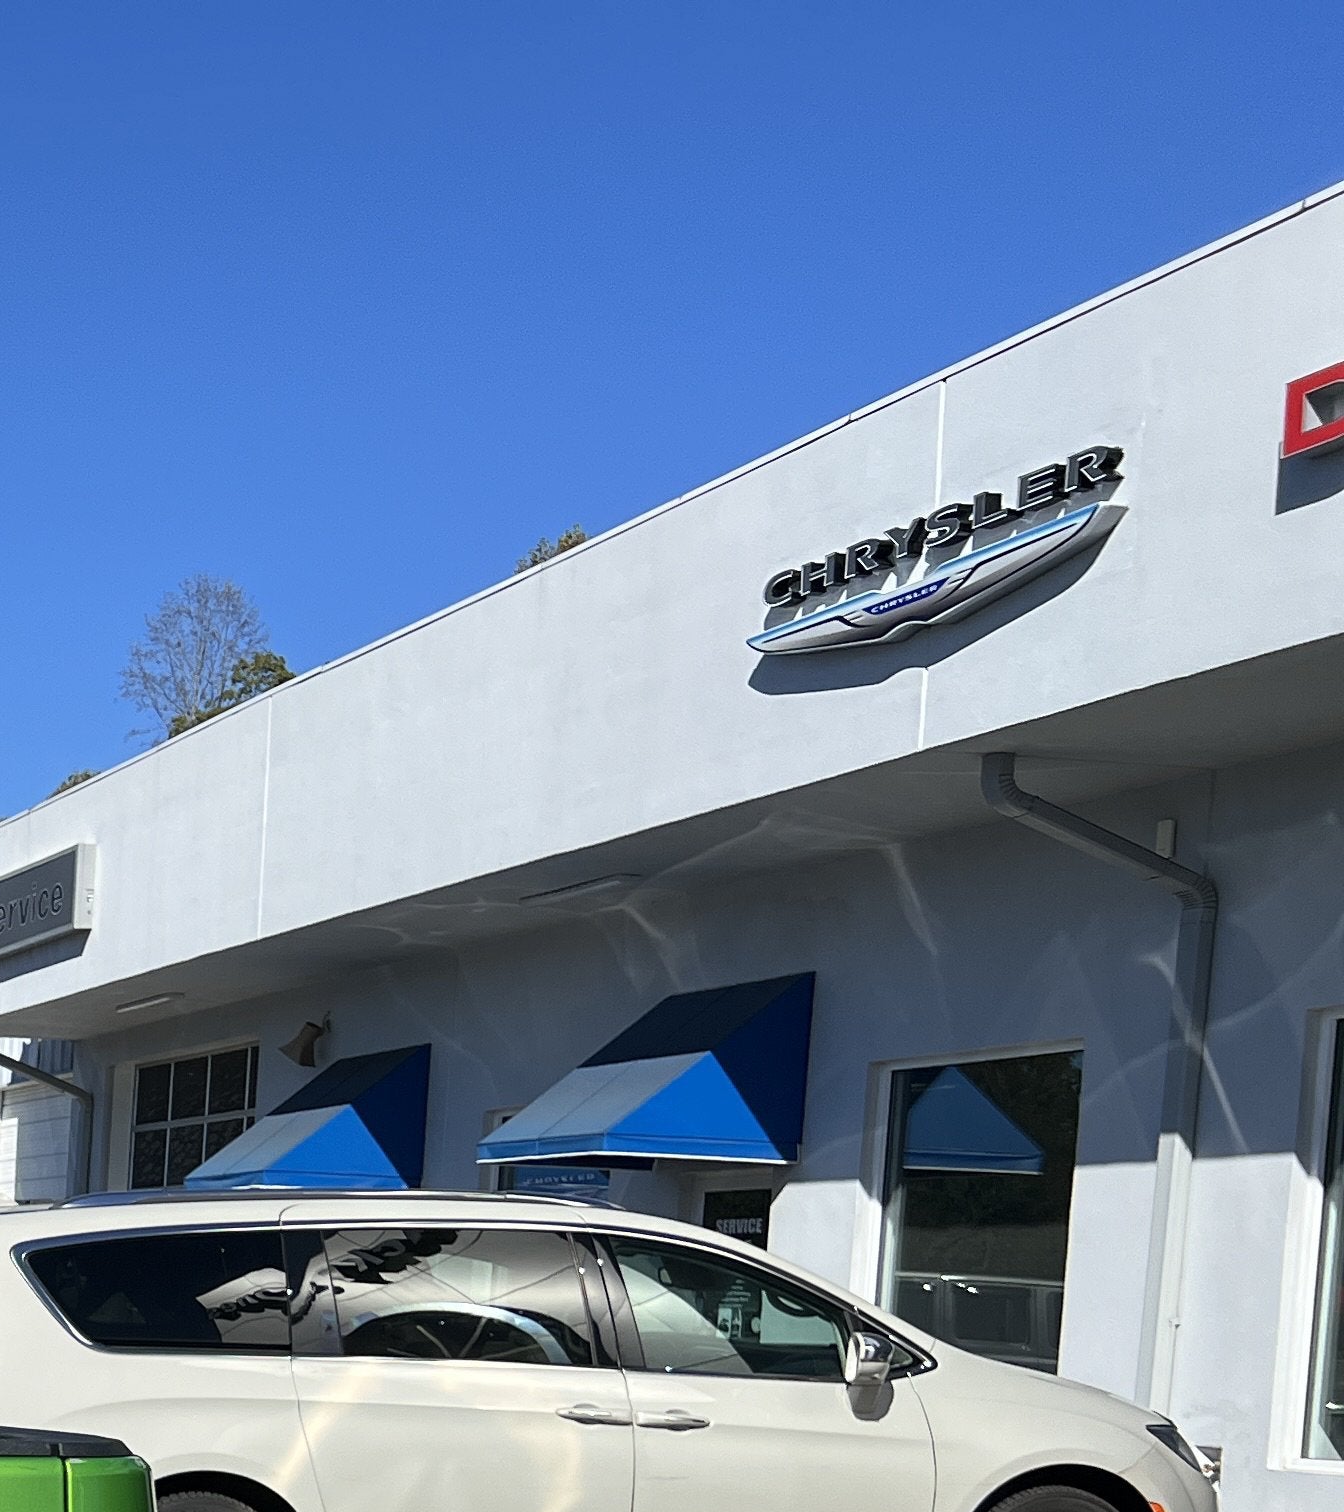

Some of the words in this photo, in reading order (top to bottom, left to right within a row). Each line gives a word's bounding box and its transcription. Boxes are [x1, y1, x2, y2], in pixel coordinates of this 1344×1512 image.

[762, 445, 1124, 608] CHRYSLER
[870, 584, 938, 614] CHRYSLER
[715, 1217, 764, 1234] SERVICE
